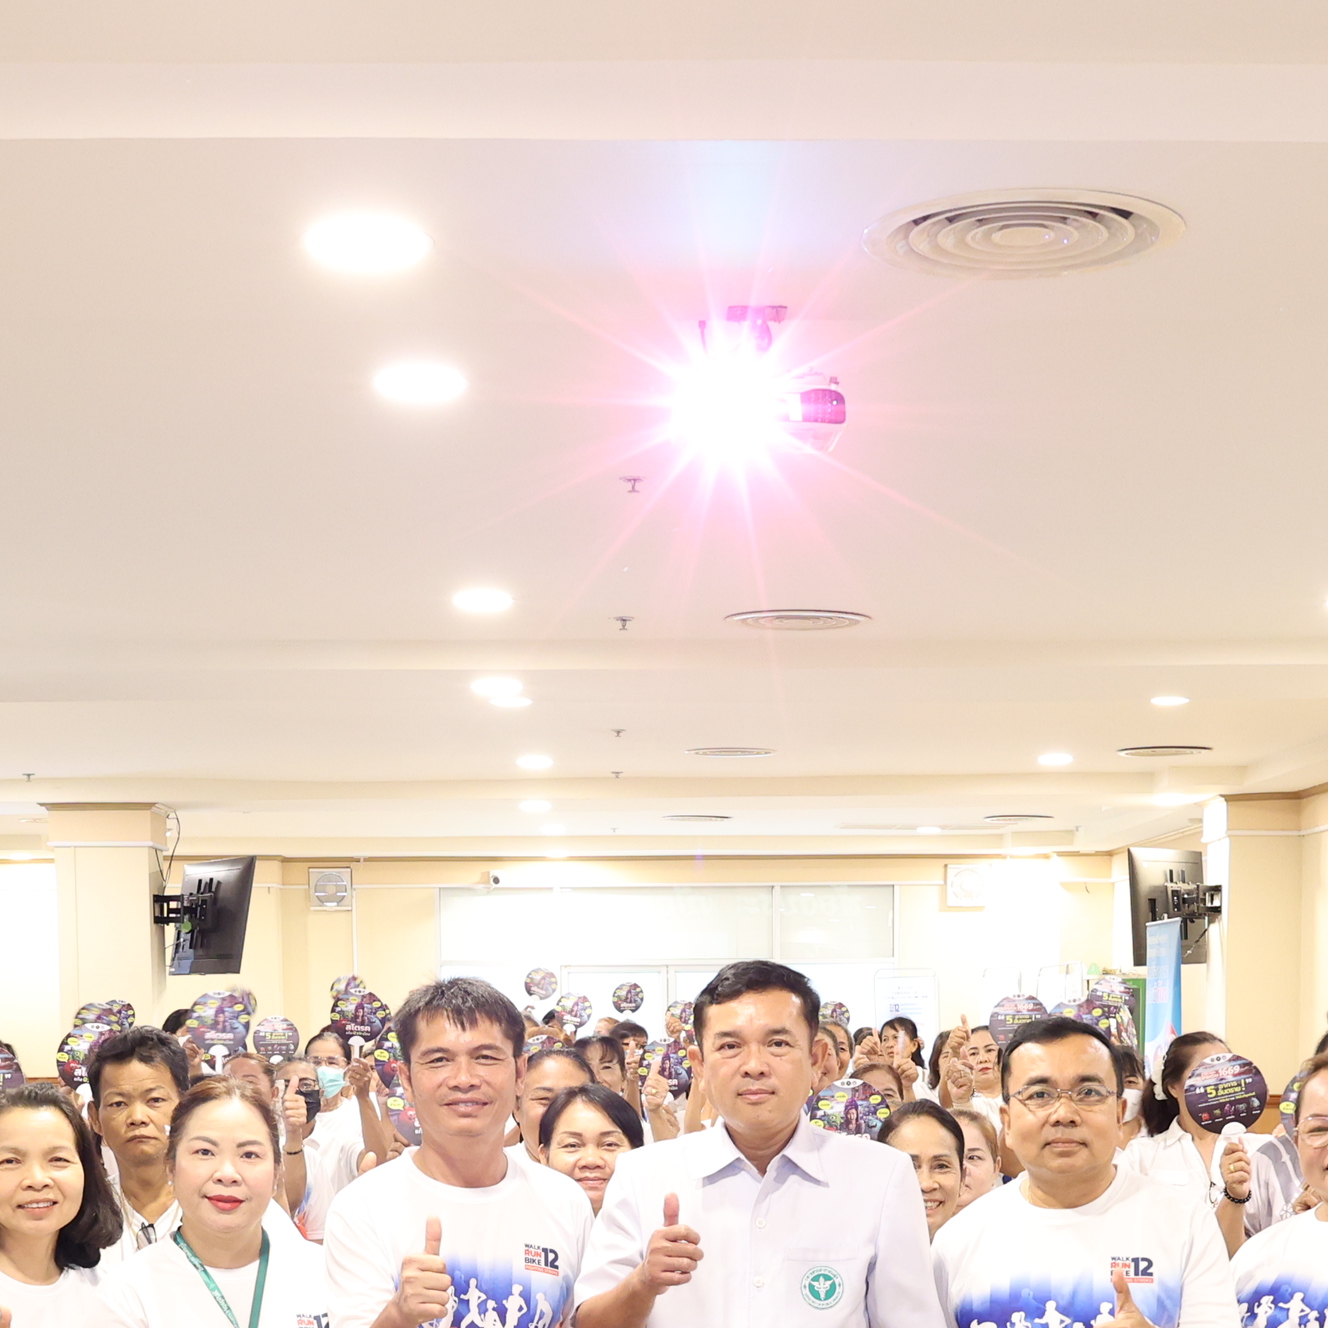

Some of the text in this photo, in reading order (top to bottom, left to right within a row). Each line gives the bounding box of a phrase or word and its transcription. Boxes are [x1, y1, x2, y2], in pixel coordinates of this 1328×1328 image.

[1218, 1065, 1240, 1077] 1669
[1206, 1086, 1217, 1098] 5
[525, 1249, 542, 1258] RUN
[542, 1247, 559, 1270] 12
[525, 1257, 542, 1266] BIKE
[1131, 1257, 1154, 1277] 12
